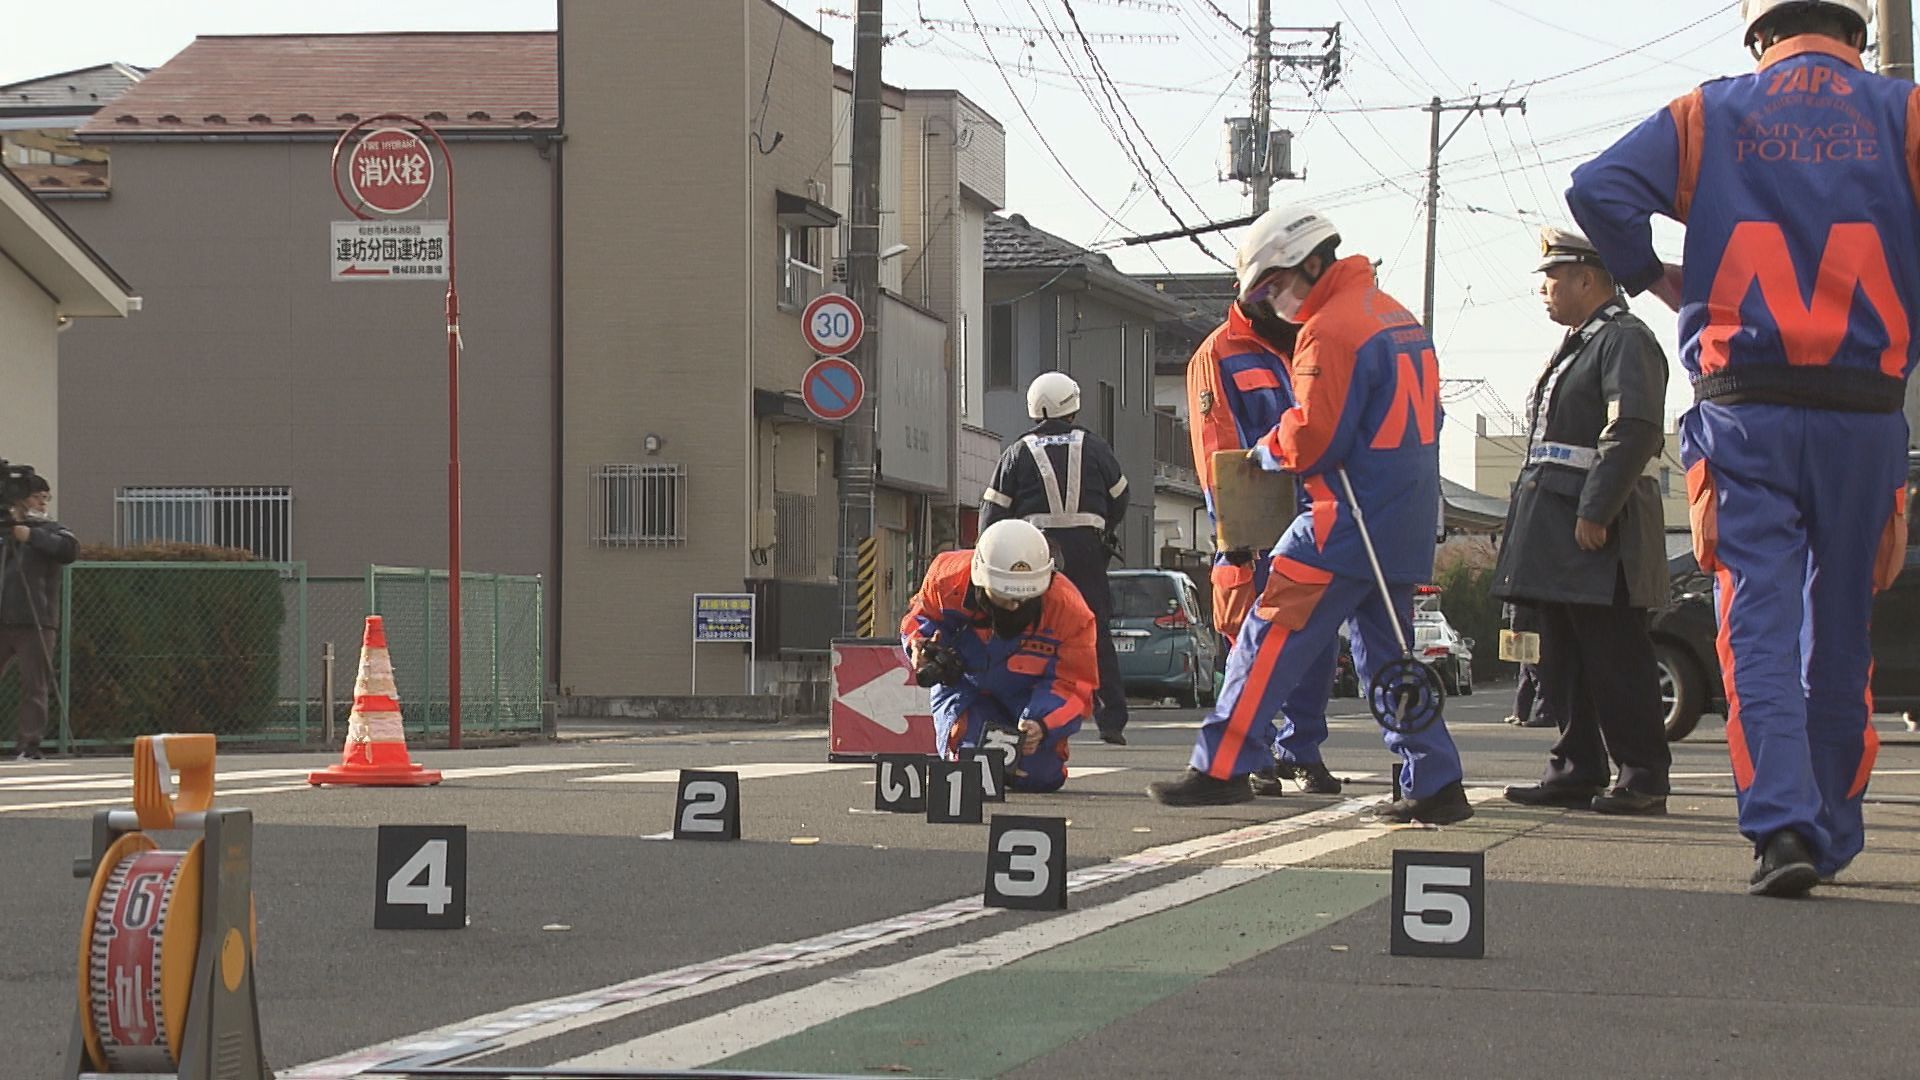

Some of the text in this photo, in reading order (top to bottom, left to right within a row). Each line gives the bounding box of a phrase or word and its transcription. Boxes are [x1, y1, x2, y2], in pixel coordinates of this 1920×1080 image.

[1766, 65, 1854, 96] TAPS
[1735, 138, 1881, 163] POLICE
[1755, 122, 1858, 142] MIYAGI
[357, 153, 427, 188] 消火栓
[336, 236, 444, 262] 連坊分団連坊部
[816, 312, 850, 338] 30
[880, 761, 922, 803] い
[945, 770, 963, 817] 1
[680, 780, 727, 833] 2
[386, 839, 453, 915] 4
[994, 828, 1052, 897] 3
[1402, 864, 1472, 944] 5
